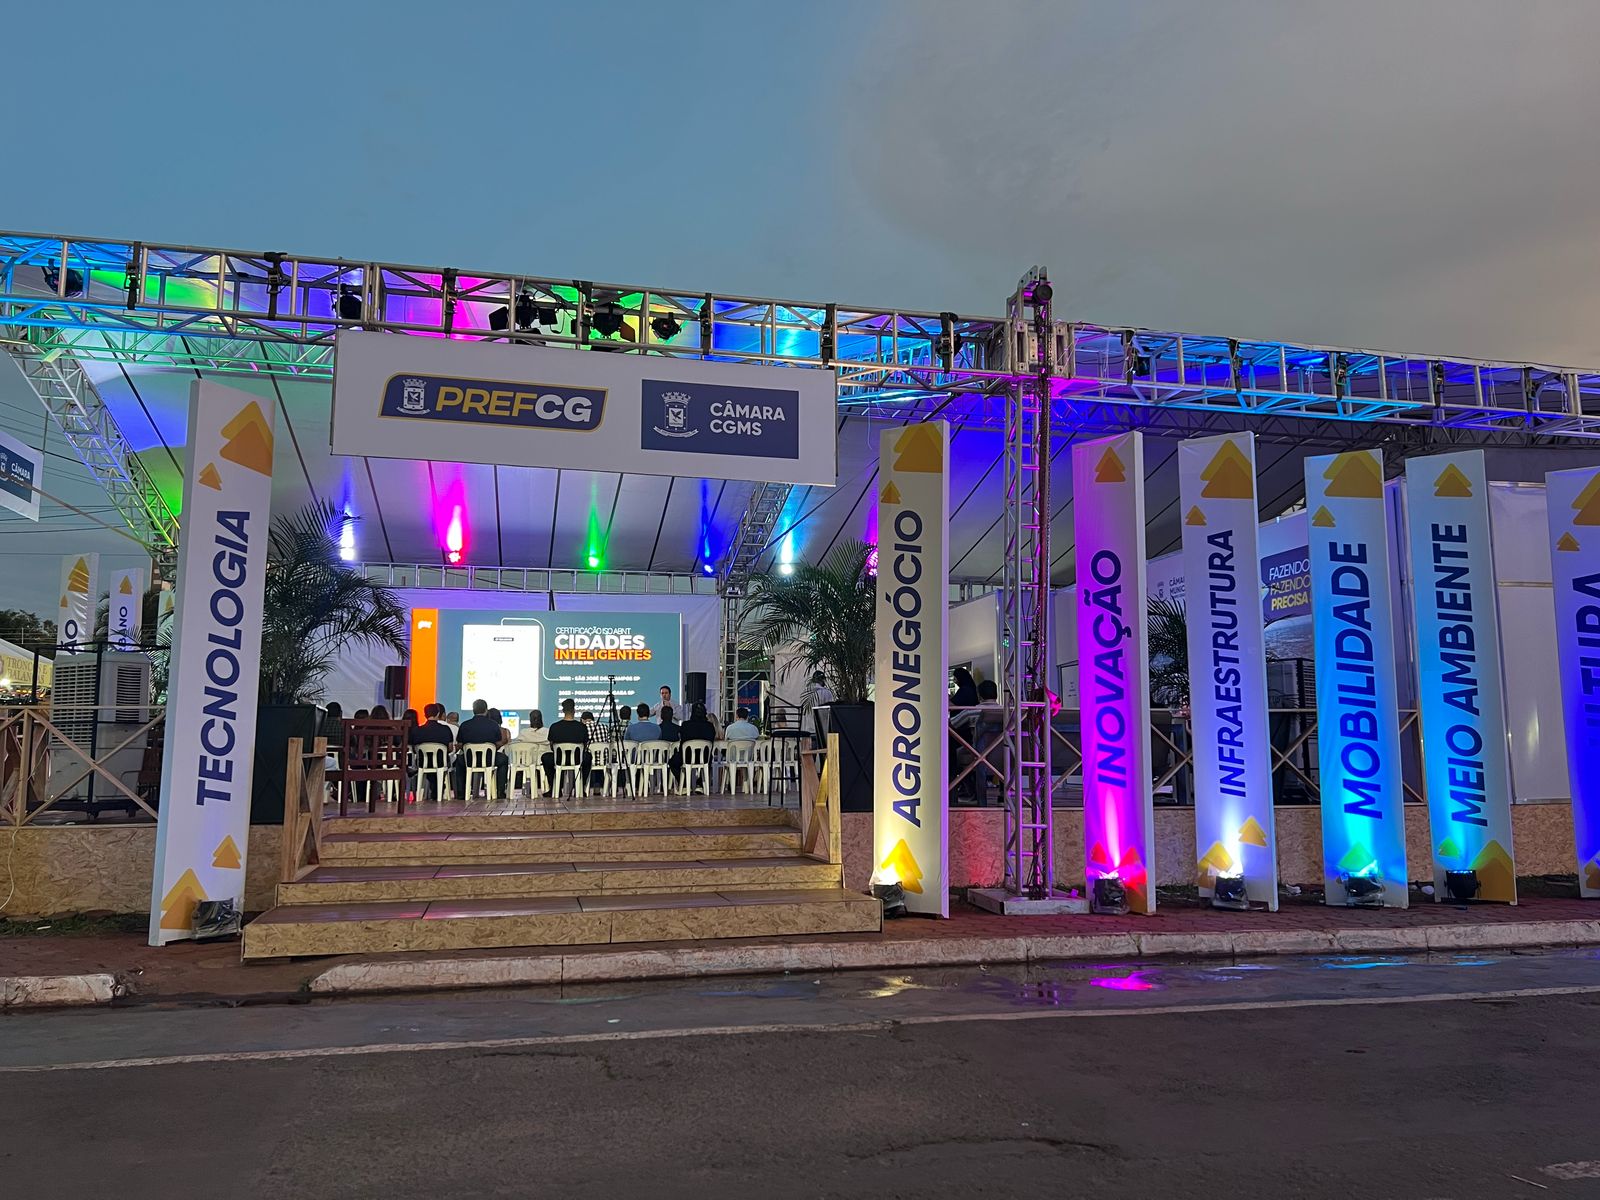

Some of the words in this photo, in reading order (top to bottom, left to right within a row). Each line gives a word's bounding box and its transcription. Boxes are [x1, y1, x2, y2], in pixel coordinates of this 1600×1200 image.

[436, 386, 592, 424] PREFCG
[709, 398, 785, 421] CÂMARA
[709, 419, 762, 436] CGMS
[1269, 558, 1310, 581] FAZENDO
[1270, 574, 1311, 596] FAZENDO
[1271, 591, 1309, 612] PRECISA
[555, 625, 601, 636] CERTIFICAÇÃO
[1430, 523, 1481, 716] AMBIENTE
[554, 634, 645, 650] CIDADES
[554, 649, 652, 661] INTELIGENTES
[197, 510, 251, 805] TECNOLOGIA
[885, 509, 923, 828] AGRONEGÓCIO
[1083, 549, 1132, 789] INOVAÇÃO
[1206, 529, 1246, 798] INFRAESTRUTURA
[1328, 541, 1383, 820] MOBILIDADE
[1443, 725, 1488, 826] MEIO
